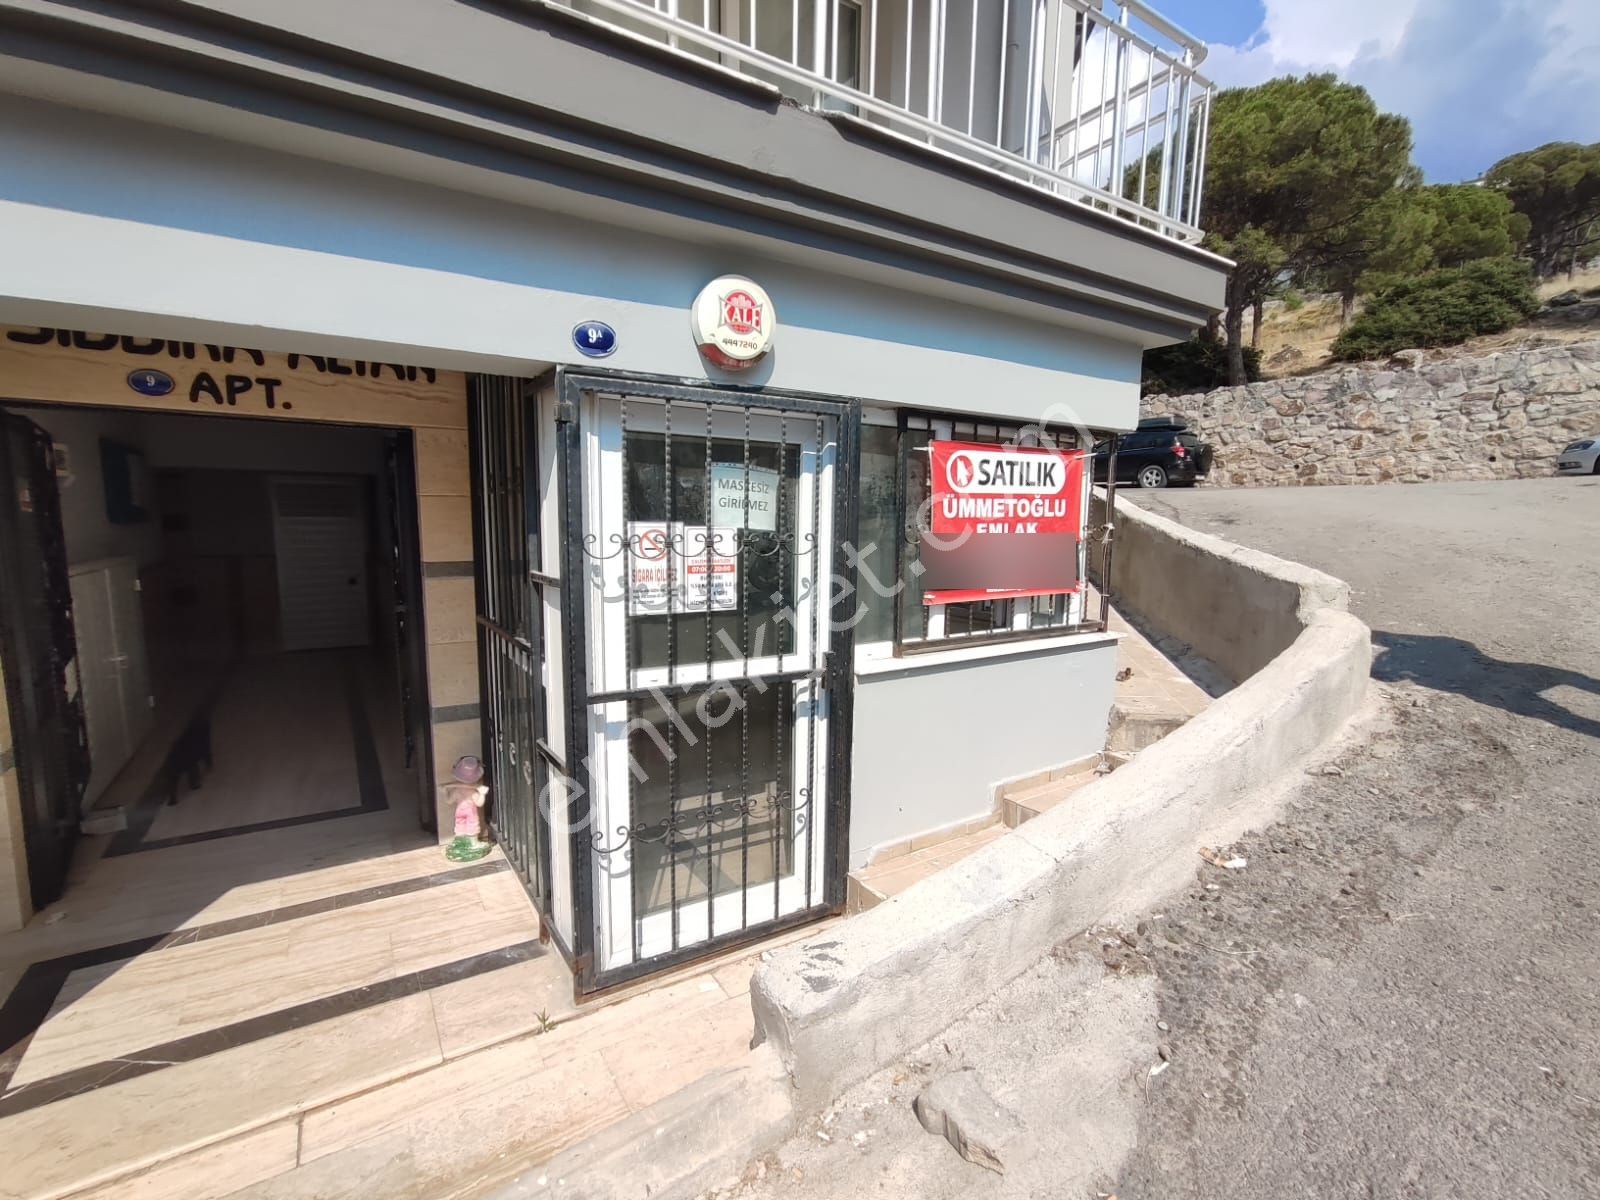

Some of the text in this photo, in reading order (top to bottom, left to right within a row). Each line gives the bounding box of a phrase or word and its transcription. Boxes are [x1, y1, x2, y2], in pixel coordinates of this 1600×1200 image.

[720, 305, 763, 330] KALE
[722, 337, 758, 350] 4447240
[146, 375, 155, 387] 9
[189, 371, 292, 409] APT.
[978, 459, 1057, 487] SATILIK
[718, 478, 769, 496] MASESİZ
[942, 493, 1067, 519] ÜMMETOĞLU
